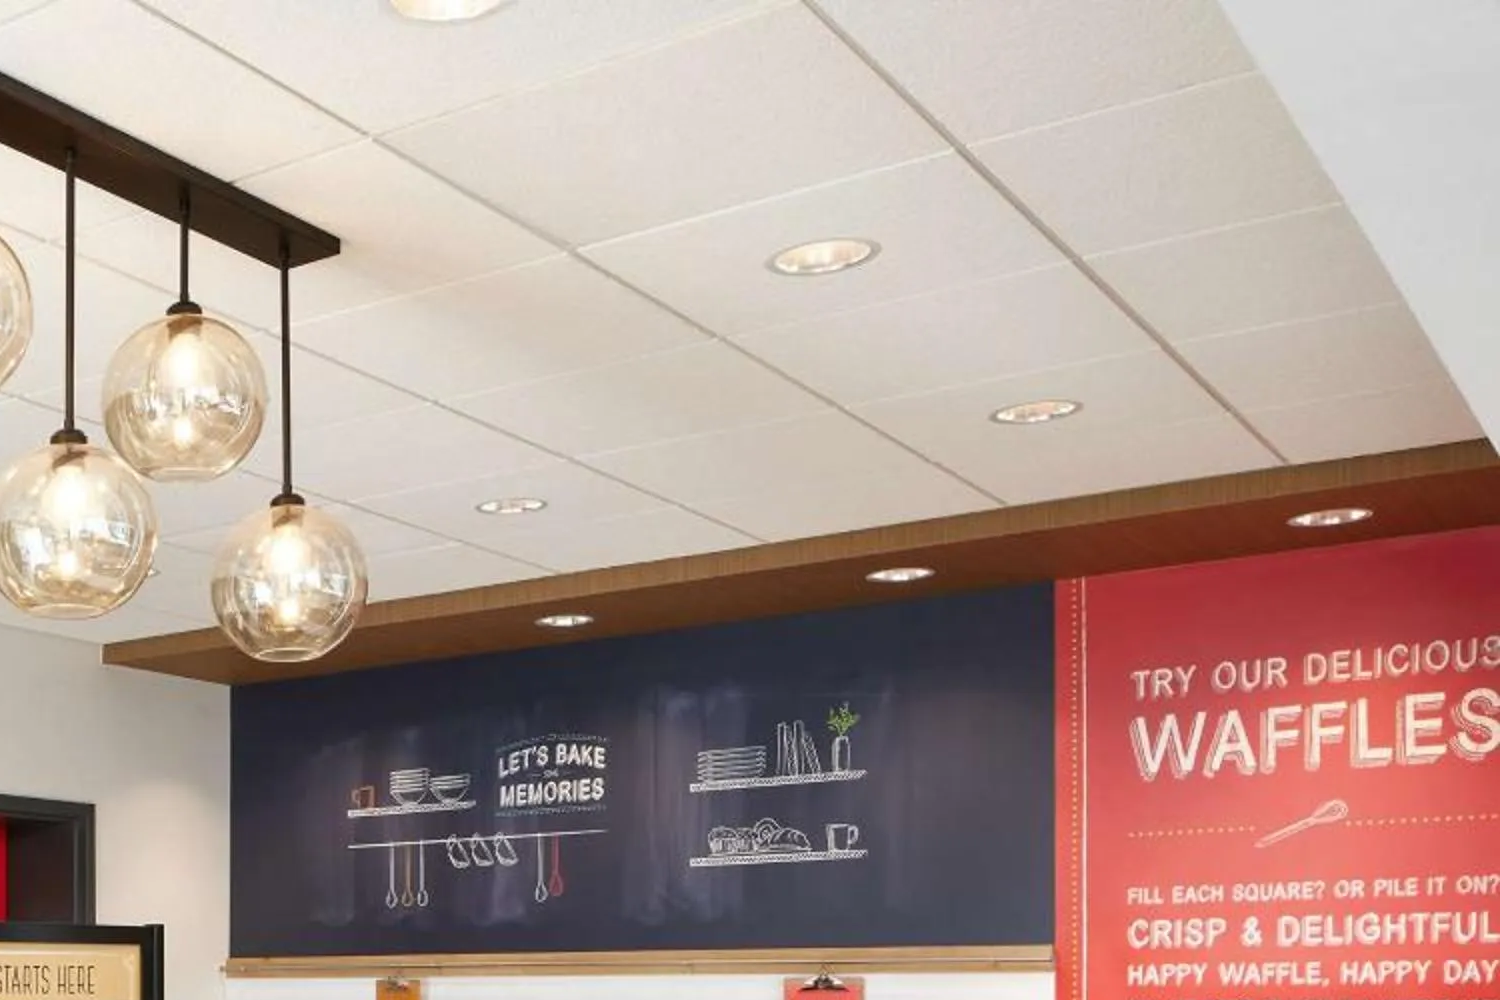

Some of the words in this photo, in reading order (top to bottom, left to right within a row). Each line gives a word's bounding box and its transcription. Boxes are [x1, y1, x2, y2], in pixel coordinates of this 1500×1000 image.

[1130, 665, 1197, 700] TRY
[1211, 657, 1289, 694] OUR
[1303, 635, 1500, 686] DELICIOUS
[1129, 688, 1500, 782] WAFFLES
[498, 745, 549, 779] LET'S
[555, 743, 606, 769] BAKE
[500, 777, 604, 808] MEMORIES
[1127, 886, 1164, 905] FILL
[1172, 884, 1224, 904] EACH
[1232, 880, 1326, 902] SQUARE?
[1333, 879, 1365, 898] OR
[1373, 876, 1419, 897] PILE
[1426, 875, 1447, 896] IT
[1455, 873, 1499, 896] ON?
[1127, 917, 1227, 949] CRISP
[1240, 915, 1263, 947] &
[1277, 911, 1500, 947] DELIGHTFUL
[57, 964, 96, 995] HERE
[1127, 962, 1207, 987] HAPPY
[1218, 961, 1330, 988] WAFFLE,
[1340, 960, 1432, 986] HAPPY
[1443, 958, 1499, 985] DAY
